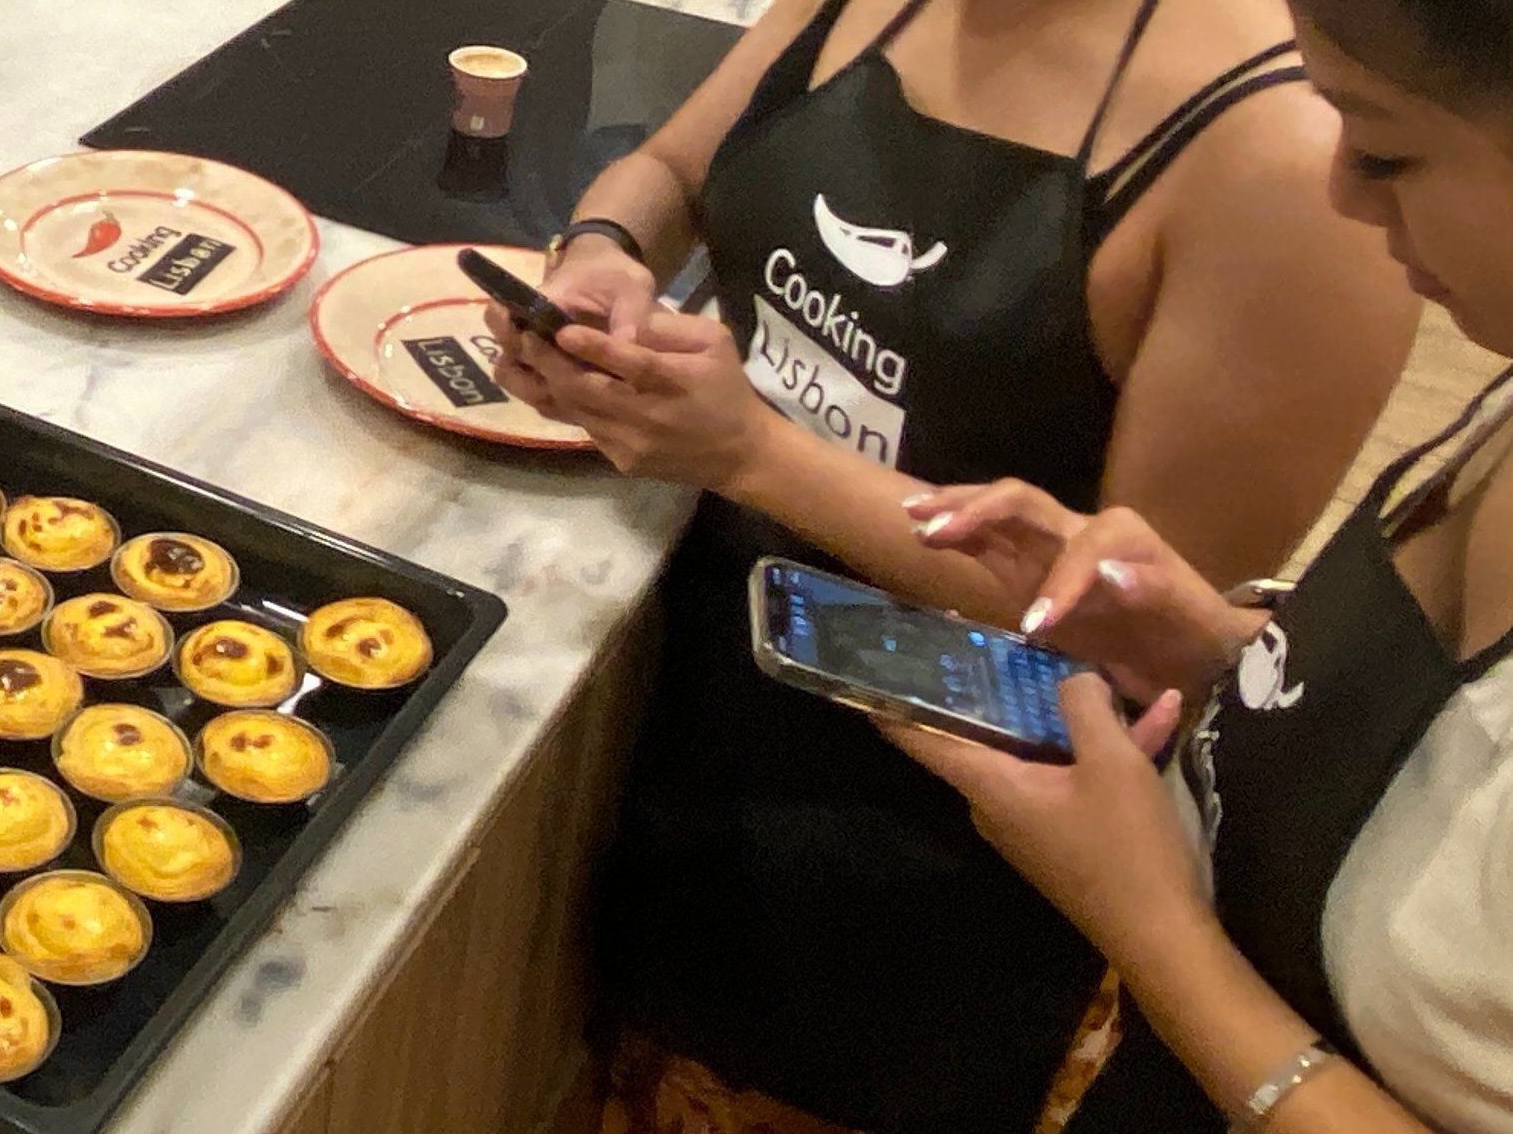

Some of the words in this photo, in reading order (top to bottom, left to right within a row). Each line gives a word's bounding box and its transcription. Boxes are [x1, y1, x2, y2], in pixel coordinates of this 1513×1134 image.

[107, 226, 182, 273] Cooking
[149, 237, 223, 291] Lisbon
[764, 248, 907, 394] Cooking
[418, 339, 485, 405] Lisbon
[758, 319, 889, 463] Lisbon
